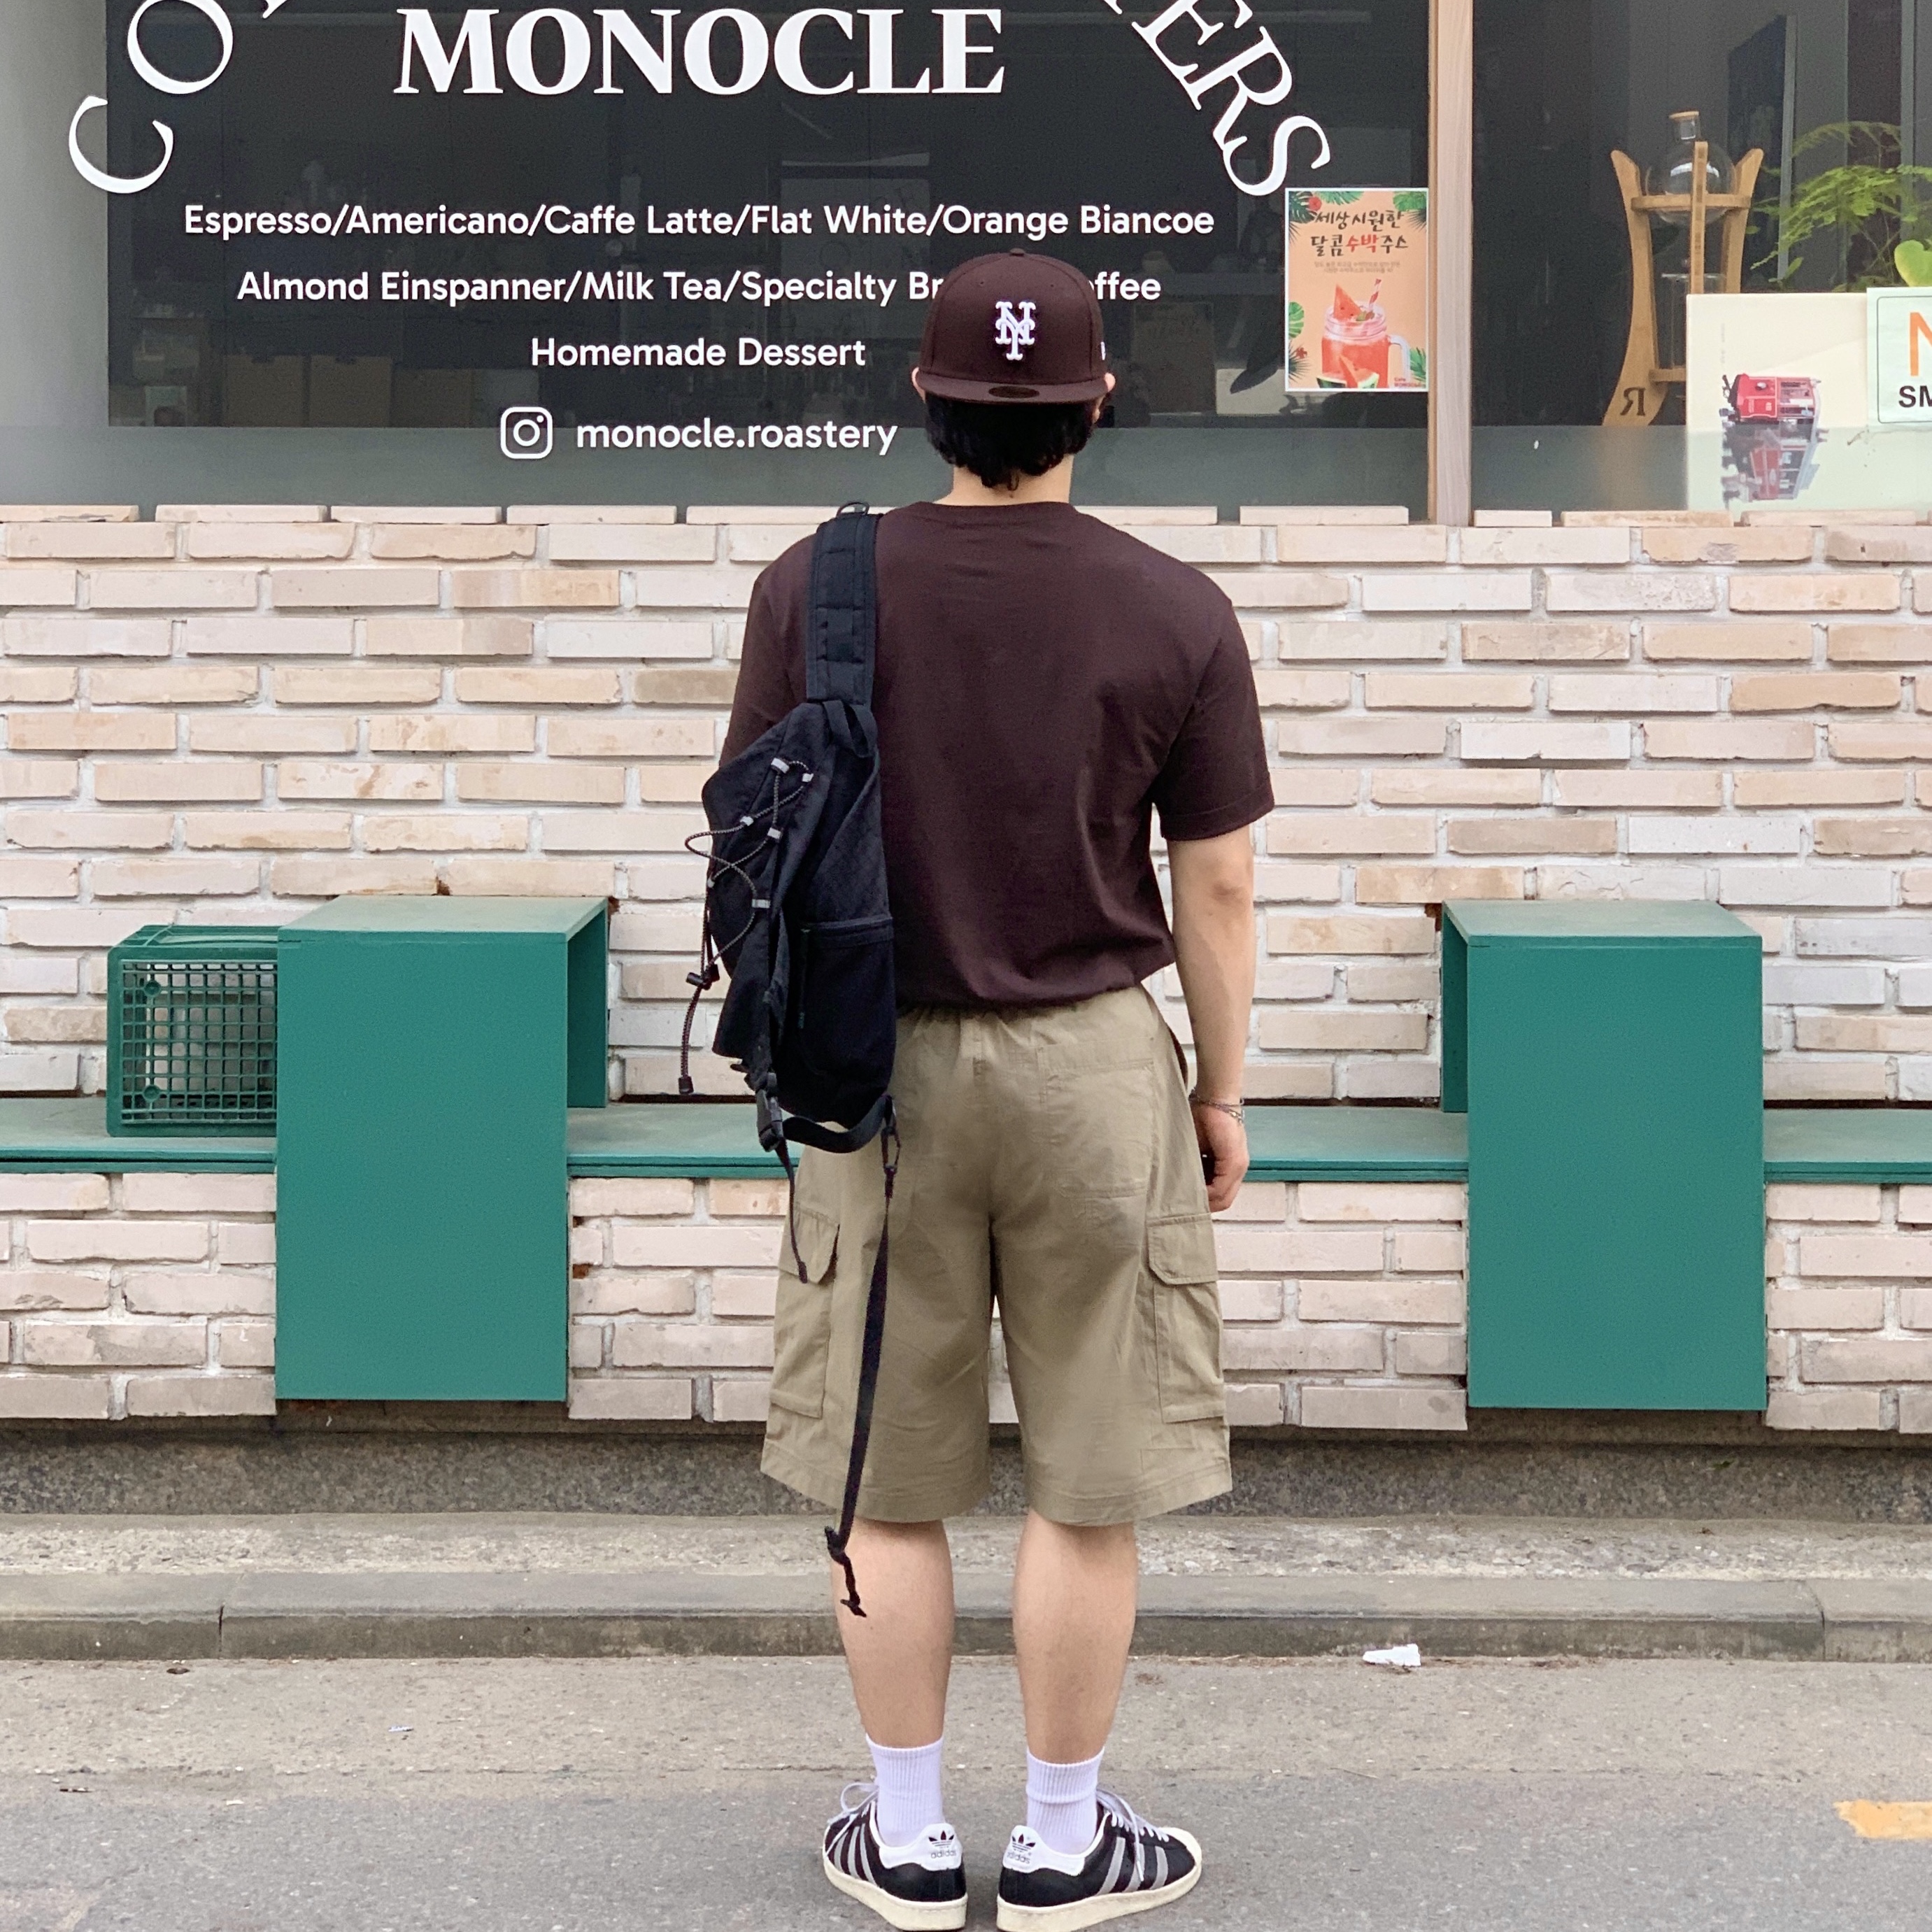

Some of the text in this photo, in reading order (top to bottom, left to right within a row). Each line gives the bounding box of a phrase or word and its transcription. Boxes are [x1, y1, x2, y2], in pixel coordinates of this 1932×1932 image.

[393, 8, 1004, 95] MONOCLE
[69, 0, 287, 194] CO
[1103, 0, 1330, 196] ERS
[185, 204, 1215, 241] Espresso/Americano/Caffe Latte/Flat White/Orange Biancoe
[236, 269, 1161, 307] Almond Einspanner/Milk Tea/Specialty Br ffee
[532, 337, 866, 367] Homemade Dessert
[577, 417, 898, 456] monocle.roastery
